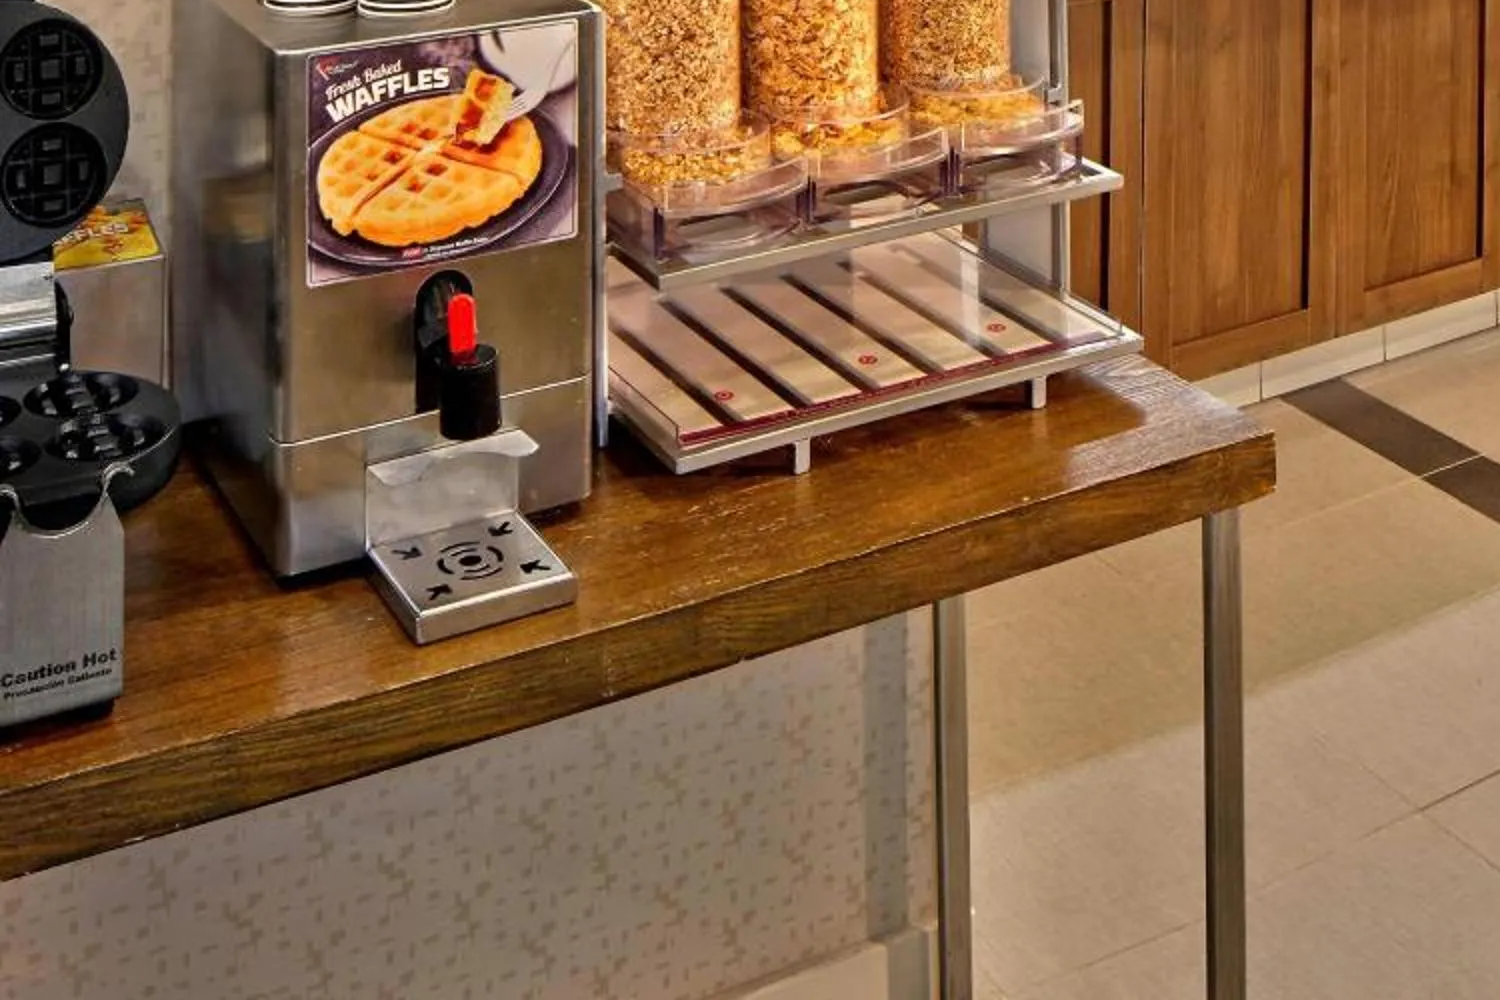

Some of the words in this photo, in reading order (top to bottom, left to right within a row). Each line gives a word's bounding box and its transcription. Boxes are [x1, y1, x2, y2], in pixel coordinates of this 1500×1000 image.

[363, 59, 402, 83] Baked
[325, 67, 450, 123] WAFFLES
[1, 659, 77, 688] Caution
[82, 647, 118, 669] Hot
